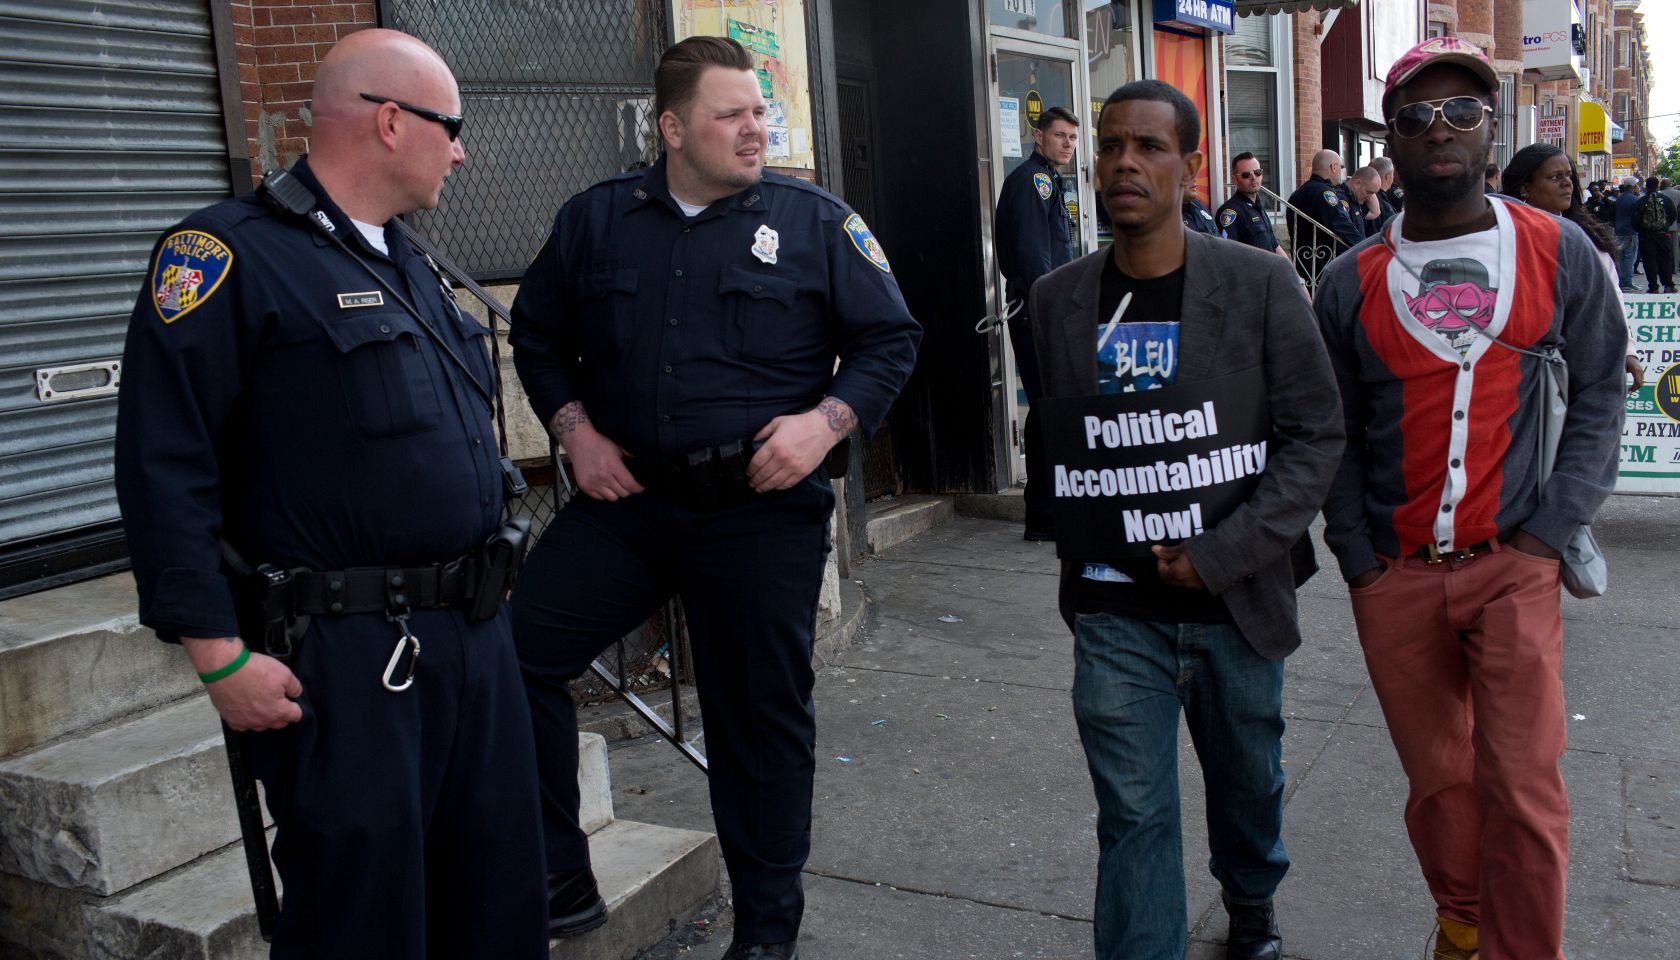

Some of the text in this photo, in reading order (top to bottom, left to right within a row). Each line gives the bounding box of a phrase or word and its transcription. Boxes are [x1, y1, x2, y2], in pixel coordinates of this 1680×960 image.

[1210, 3, 1231, 26] ATM
[1580, 131, 1605, 145] LOTTERY
[167, 234, 228, 260] BALTIMORE
[173, 244, 211, 262] POLICE
[1624, 302, 1680, 319] CHE
[1629, 325, 1680, 342] SH
[1114, 338, 1174, 378] BLEU
[1084, 401, 1218, 449] Political
[1054, 440, 1267, 497] Accountability
[1122, 503, 1204, 543] Now!
